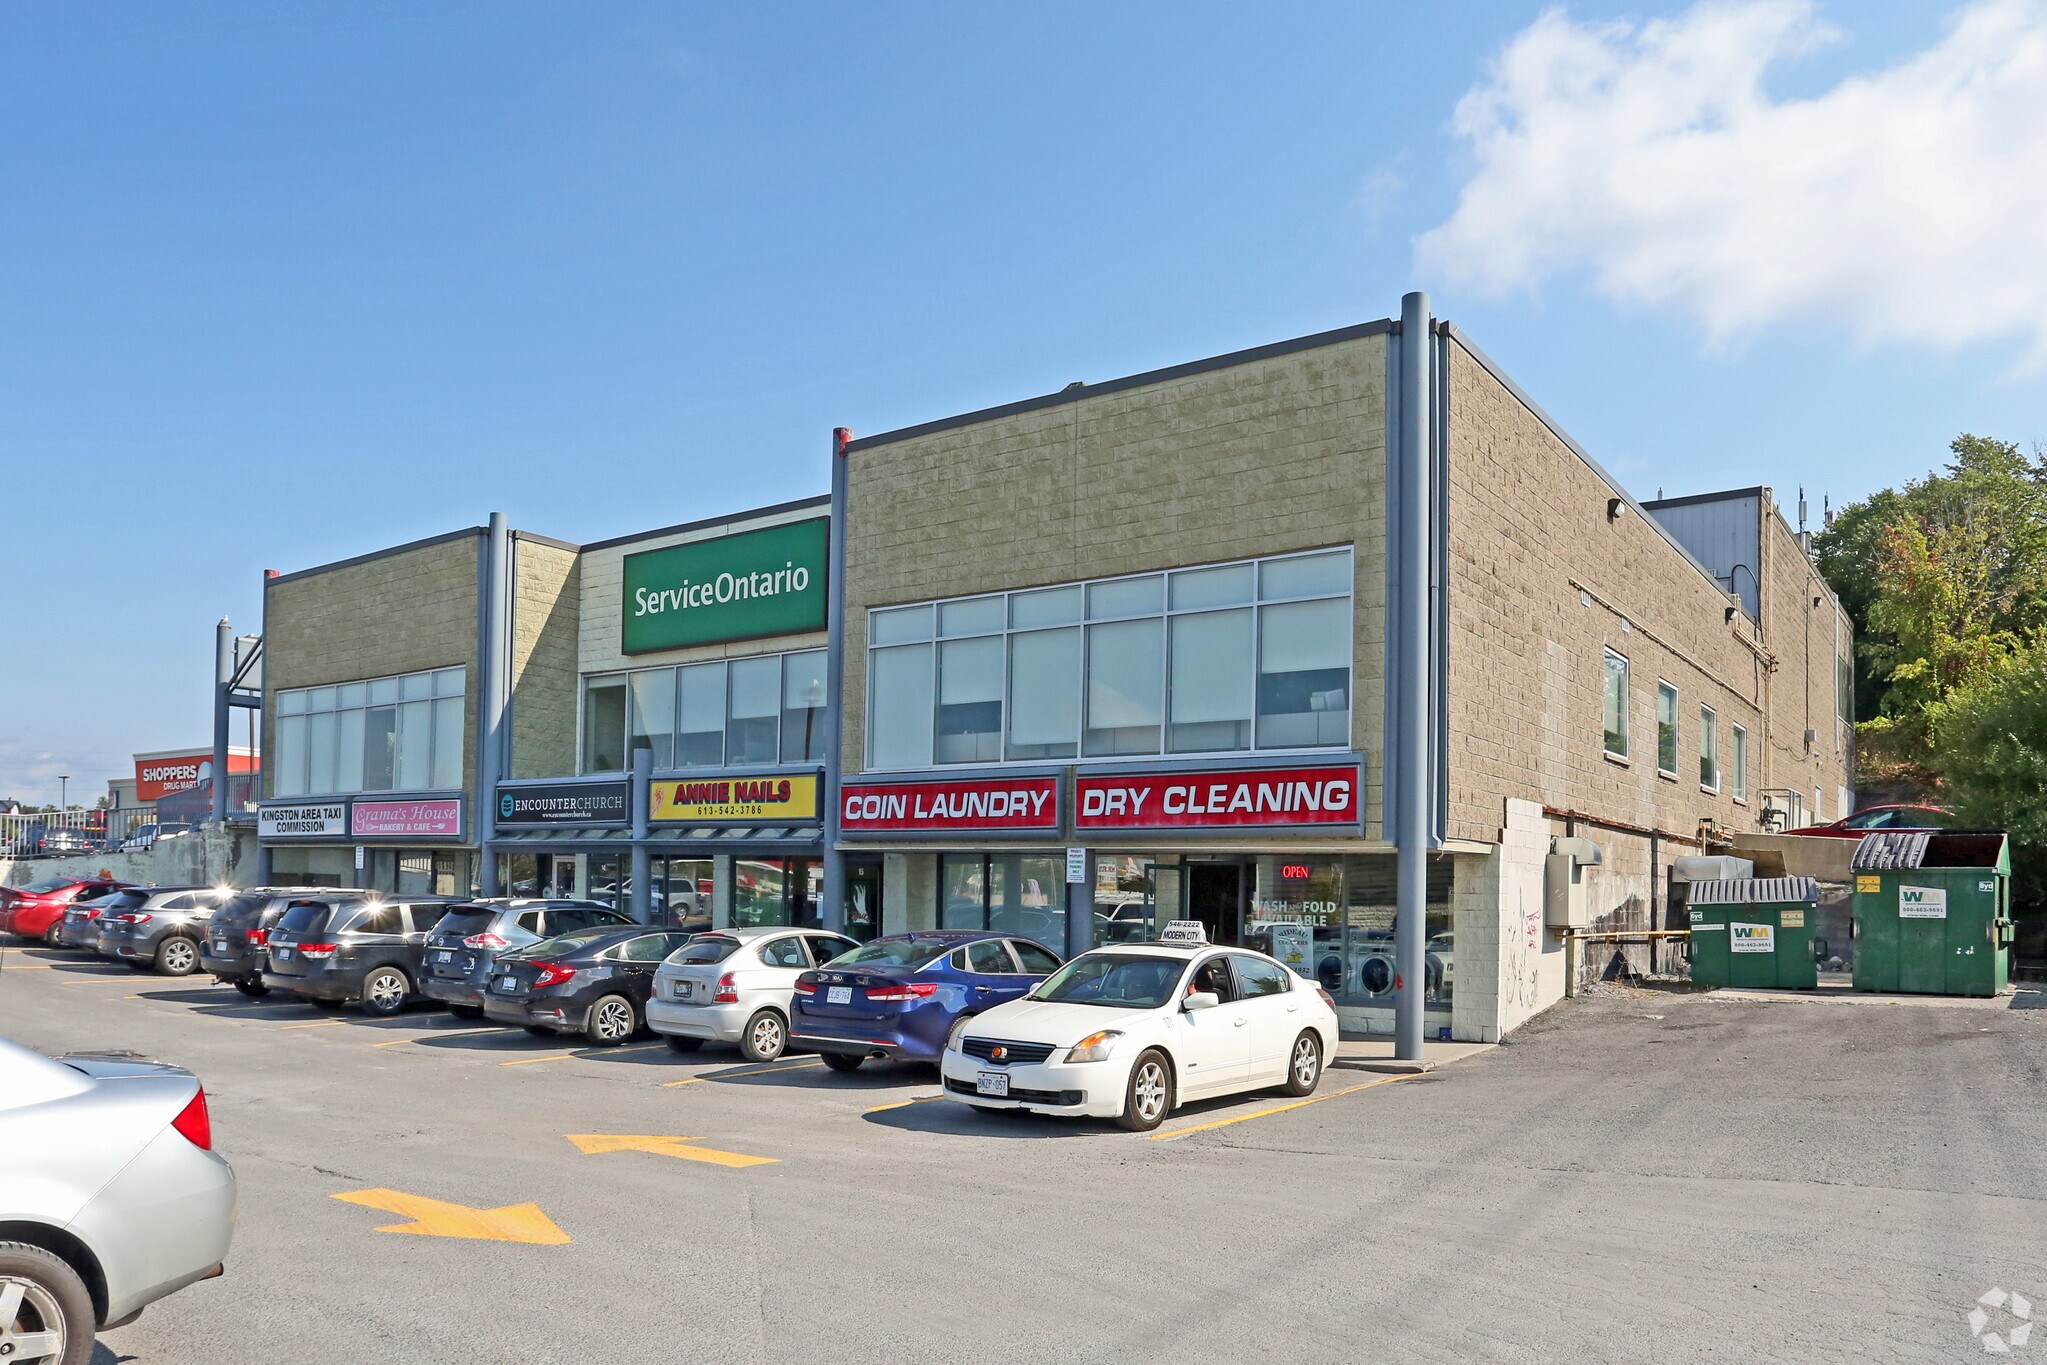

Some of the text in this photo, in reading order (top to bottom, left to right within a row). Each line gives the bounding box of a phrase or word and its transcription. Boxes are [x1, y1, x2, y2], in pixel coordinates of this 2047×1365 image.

[634, 561, 809, 617] ServiceOntario
[143, 765, 197, 782] SHOPPERS
[163, 780, 198, 791] DRUG MART
[673, 780, 792, 806] ANNIE NAILS
[1082, 779, 1350, 817] DRY CLEANING
[514, 796, 623, 812] ENCOUNTERCHURCH
[697, 805, 762, 816] 613-542-3786
[845, 789, 1051, 820] COIN LAUNDRY
[261, 808, 342, 821] KINGSTON AREA TAXI
[355, 804, 456, 832] Grama's House
[276, 821, 325, 833] COMMISSION
[378, 823, 431, 831] BAKERY & CAFE
[1282, 866, 1309, 878] OPEN
[1903, 891, 1941, 902] WM
[1253, 900, 1287, 912] WASH
[1303, 901, 1337, 913] FOLD
[1263, 914, 1327, 927] AVAILABLE
[1163, 930, 1200, 940] MODERN CITY
[1734, 927, 1769, 938] WM
